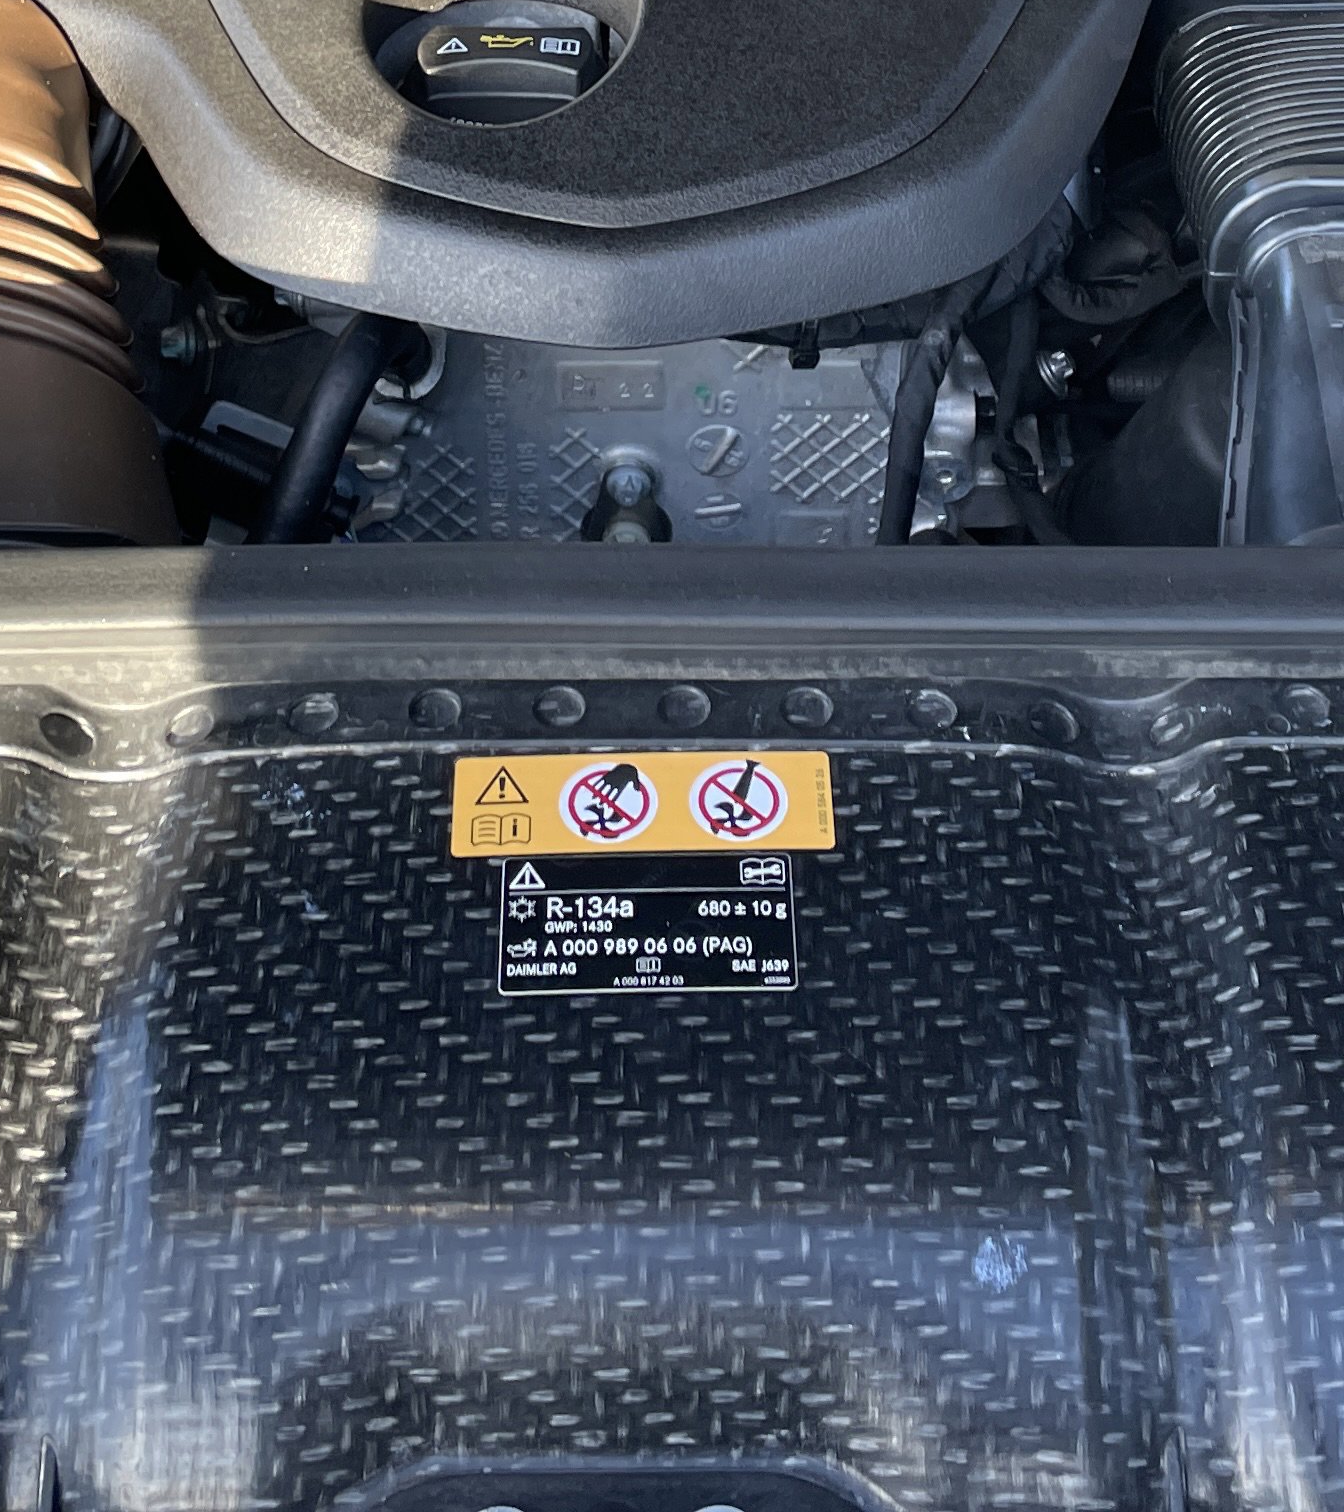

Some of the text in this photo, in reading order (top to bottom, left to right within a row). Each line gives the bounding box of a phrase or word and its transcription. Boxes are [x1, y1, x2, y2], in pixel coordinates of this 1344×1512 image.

[546, 895, 635, 920] R-134a
[697, 899, 731, 917] 680
[752, 899, 772, 917] 10
[775, 902, 788, 920] g
[544, 919, 613, 934] GWP: 1430
[544, 935, 753, 958] A 000 989 06 06 (PAG)
[506, 958, 790, 977] DAIMLER AG SAE J639
